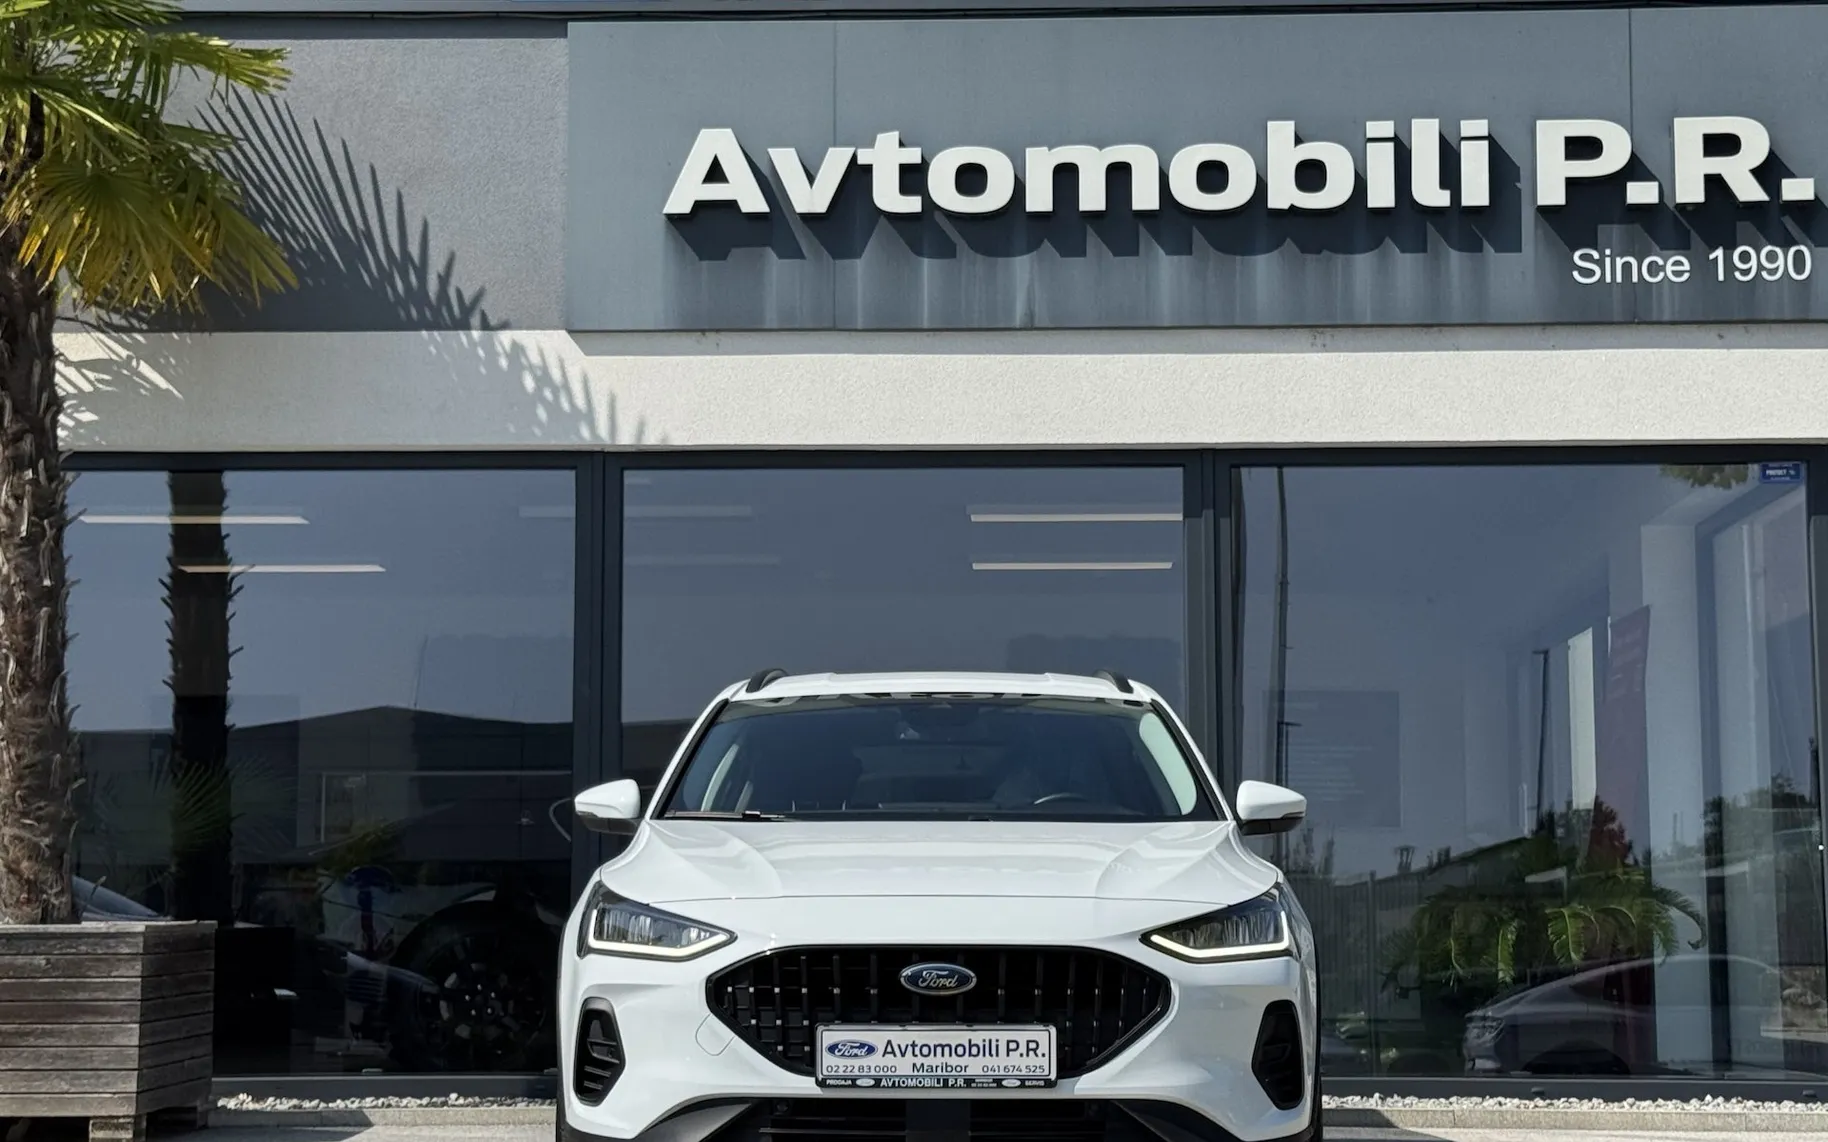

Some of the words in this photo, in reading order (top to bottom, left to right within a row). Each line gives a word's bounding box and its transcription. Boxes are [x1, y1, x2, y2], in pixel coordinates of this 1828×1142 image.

[663, 119, 1489, 213] Avtomobili
[1537, 117, 1815, 206] P.R.
[1573, 248, 1690, 284] Since
[1709, 246, 1812, 282] 1990
[918, 970, 958, 988] Ford
[834, 1042, 868, 1057] Ford
[882, 1038, 1000, 1058] Avtomobili
[1006, 1040, 1046, 1058] P.R.
[826, 1065, 840, 1074] 02
[842, 1065, 856, 1074] 22
[857, 1065, 872, 1074] 83
[874, 1065, 898, 1074] 000
[912, 1062, 969, 1074] Maribor
[982, 1065, 1000, 1074] 041
[1003, 1065, 1022, 1074] 674
[1025, 1065, 1045, 1074] 525
[880, 1078, 943, 1088] AVTOMOBILI
[948, 1078, 967, 1088] P.R.
